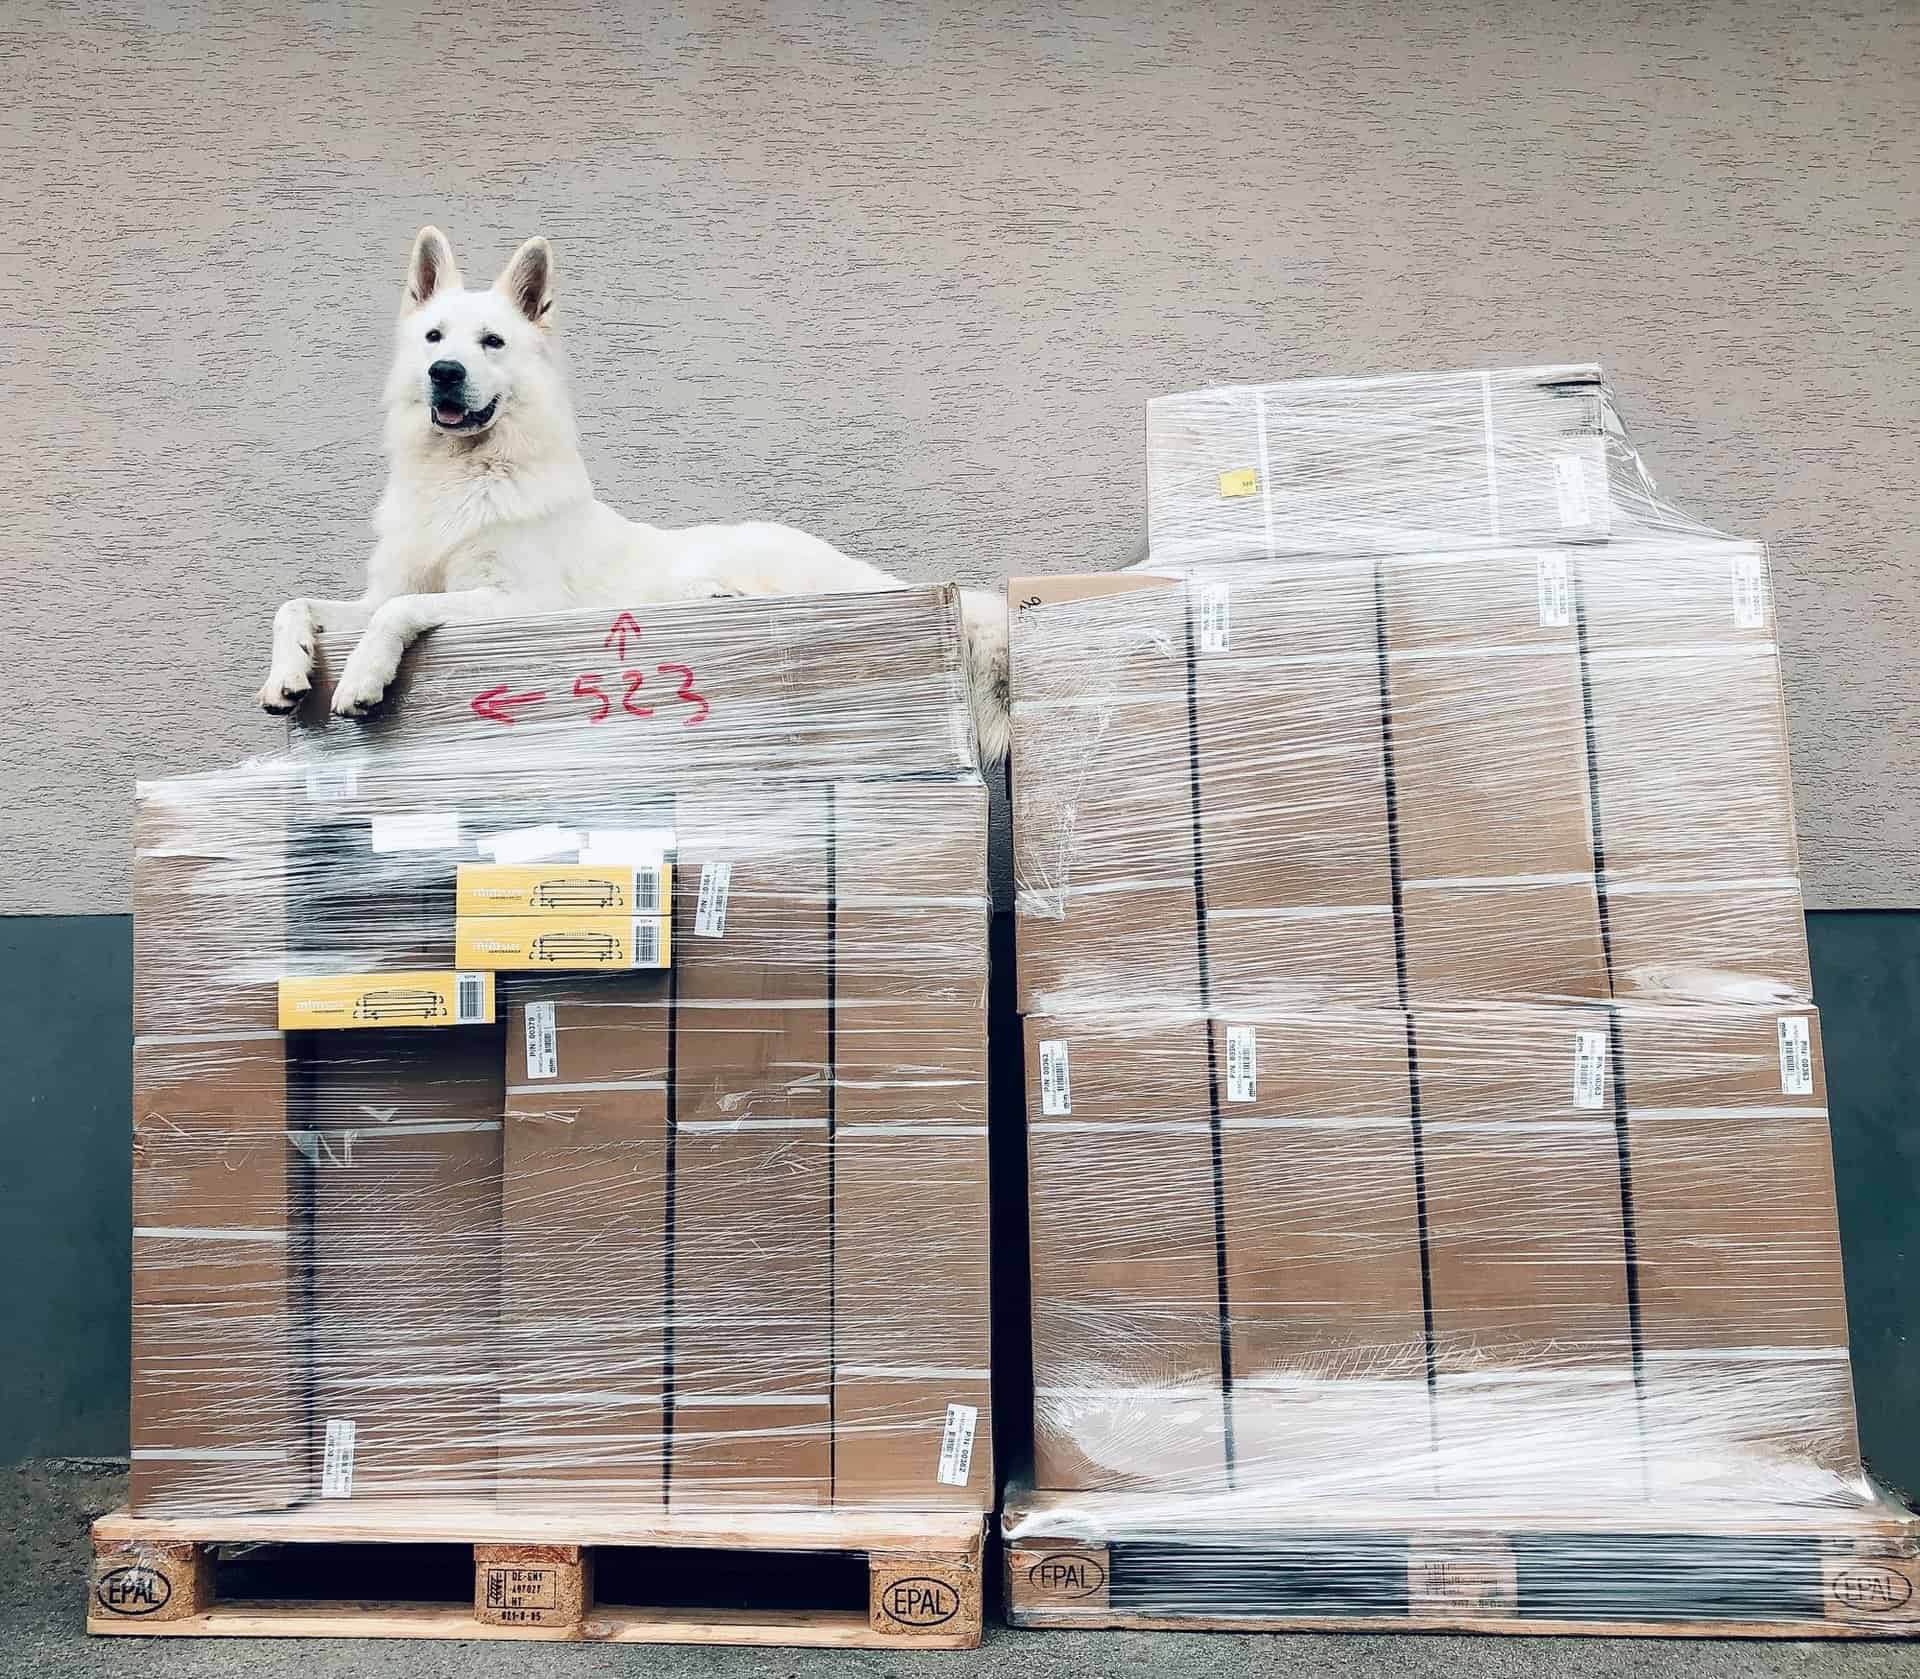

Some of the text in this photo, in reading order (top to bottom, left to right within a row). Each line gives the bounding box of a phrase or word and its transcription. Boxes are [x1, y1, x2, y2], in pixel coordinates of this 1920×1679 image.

[573, 663, 709, 727] 523
[1041, 1565, 1093, 1589] EPAL
[1844, 1576, 1903, 1601] EPAL
[109, 1577, 160, 1604] EPAL
[511, 1596, 523, 1607] HT
[894, 1588, 949, 1615] EPAL
